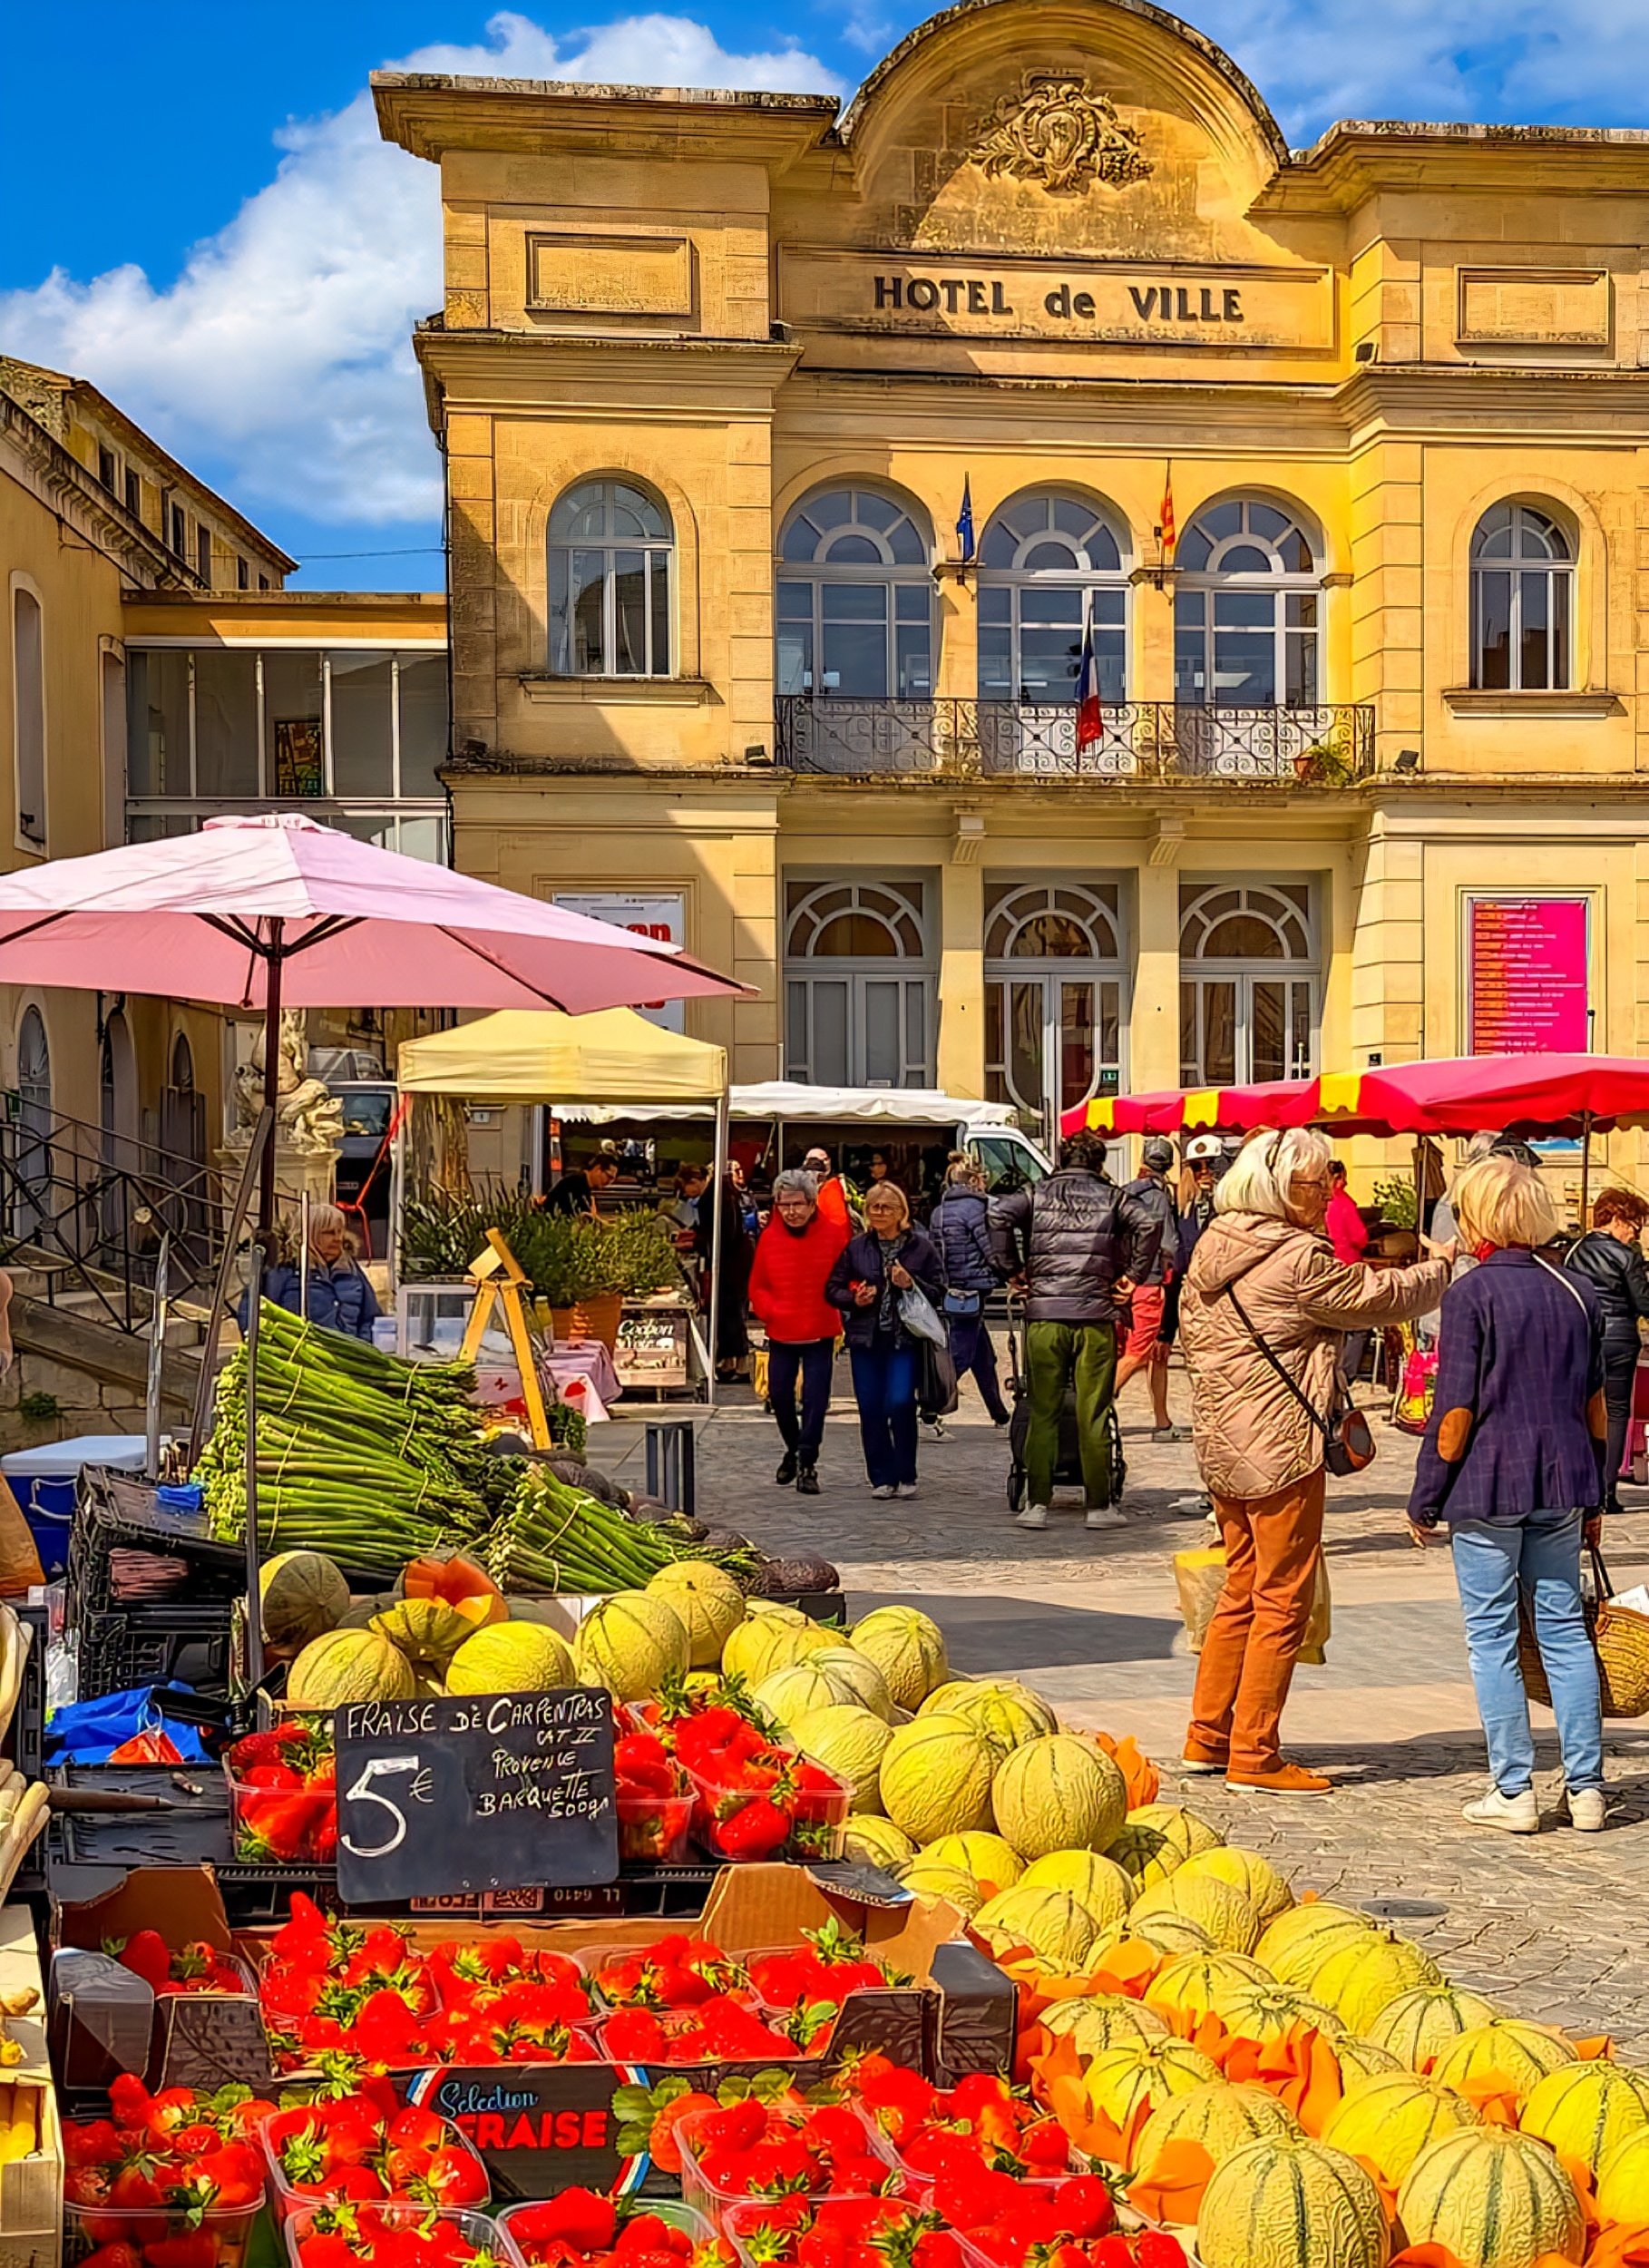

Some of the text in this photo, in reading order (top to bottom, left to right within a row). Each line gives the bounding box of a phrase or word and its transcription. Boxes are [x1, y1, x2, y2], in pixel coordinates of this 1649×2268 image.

[874, 277, 1244, 322] HOTEL de VILLE
[487, 1694, 606, 1735] CARPENTRAS
[455, 2111, 606, 2148] FRAISE
